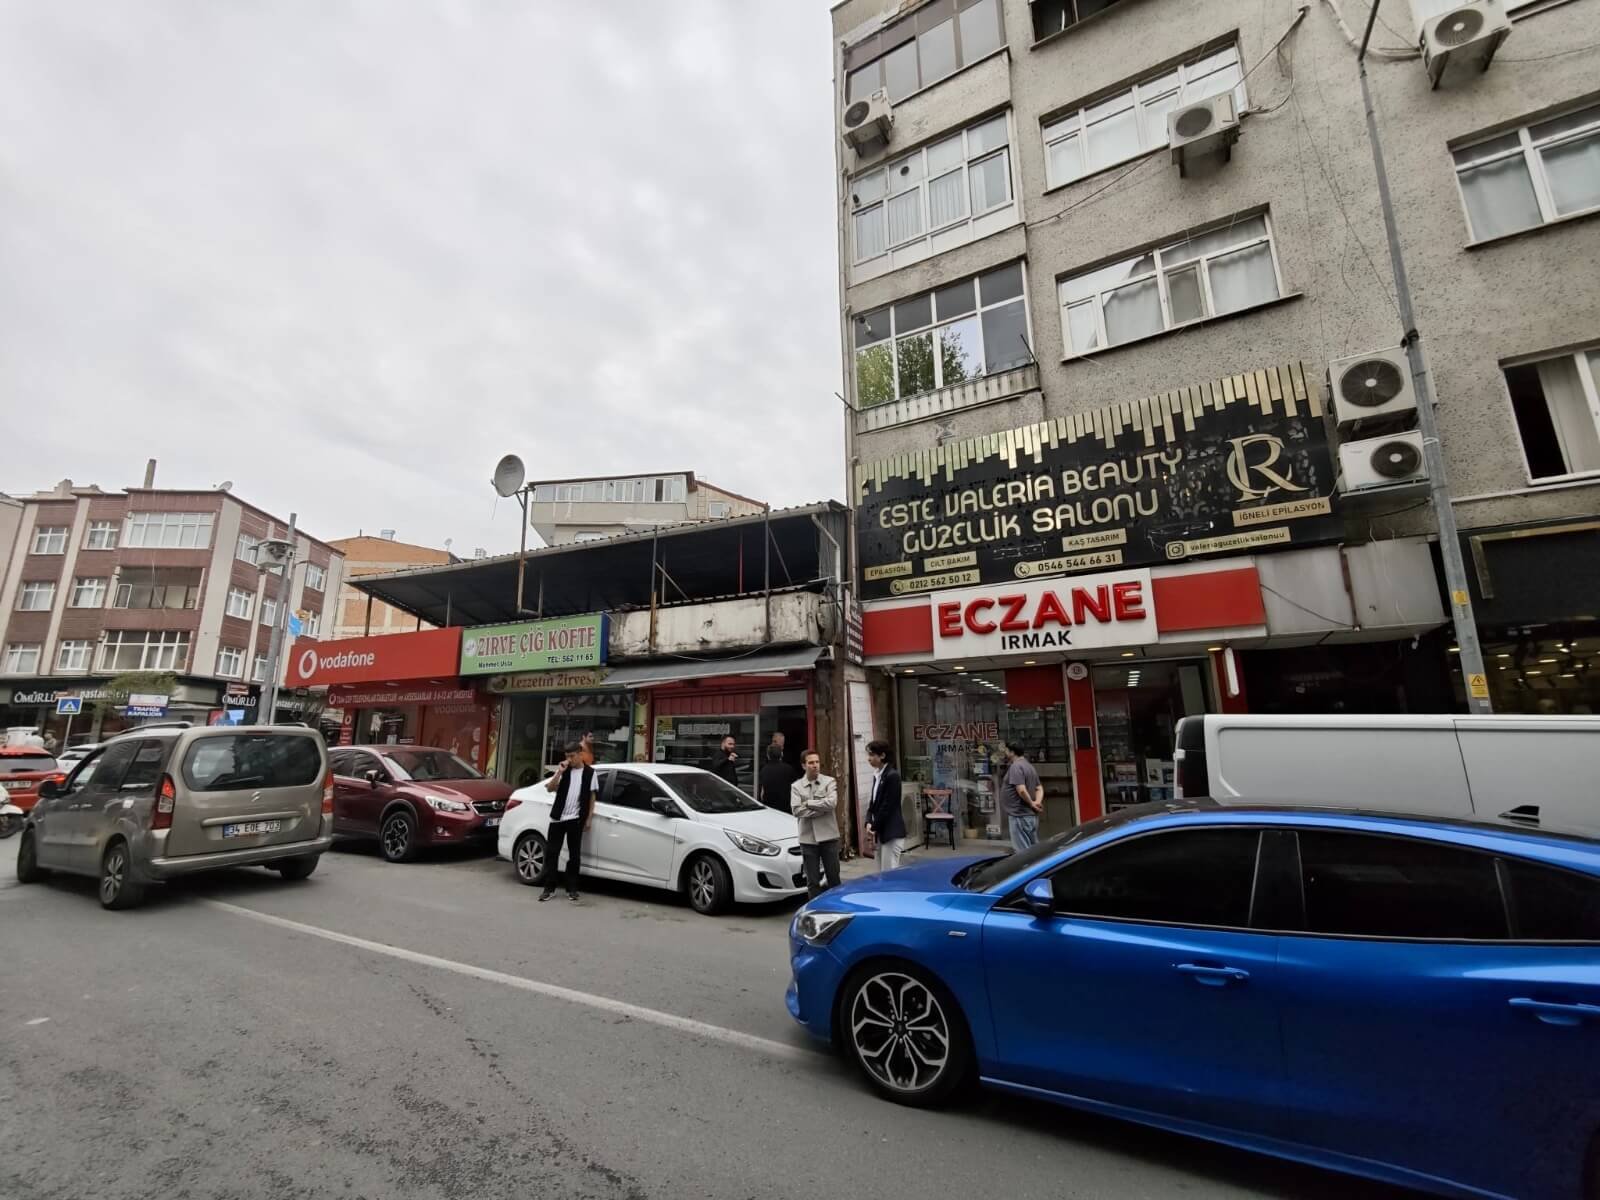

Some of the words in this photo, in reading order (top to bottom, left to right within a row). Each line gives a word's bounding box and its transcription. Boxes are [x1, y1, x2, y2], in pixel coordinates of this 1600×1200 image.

[879, 498, 934, 528] ESTE
[1063, 448, 1183, 496] BEAUTY
[903, 512, 1021, 554] GÜZELLİK
[1032, 489, 1159, 533] SALONU
[1087, 533, 1120, 545] TASARIM
[1038, 562, 1063, 572] 0546
[1067, 559, 1086, 568] 544
[1089, 557, 1102, 565] 66
[1105, 554, 1116, 563] 31
[909, 578, 928, 589] 0212
[931, 577, 945, 587] 562
[949, 575, 960, 584] 50
[962, 573, 972, 582] 12
[938, 581, 1147, 638] ECZANE
[477, 632, 516, 657] ZİRVE
[520, 627, 545, 658] ÇİĞ
[548, 623, 596, 651] KÖFTE
[1001, 630, 1073, 650] IRMAK
[319, 650, 375, 671] vodafone
[585, 653, 594, 661] 65
[913, 721, 999, 742] ECZANE
[938, 743, 974, 754] IRMAK
